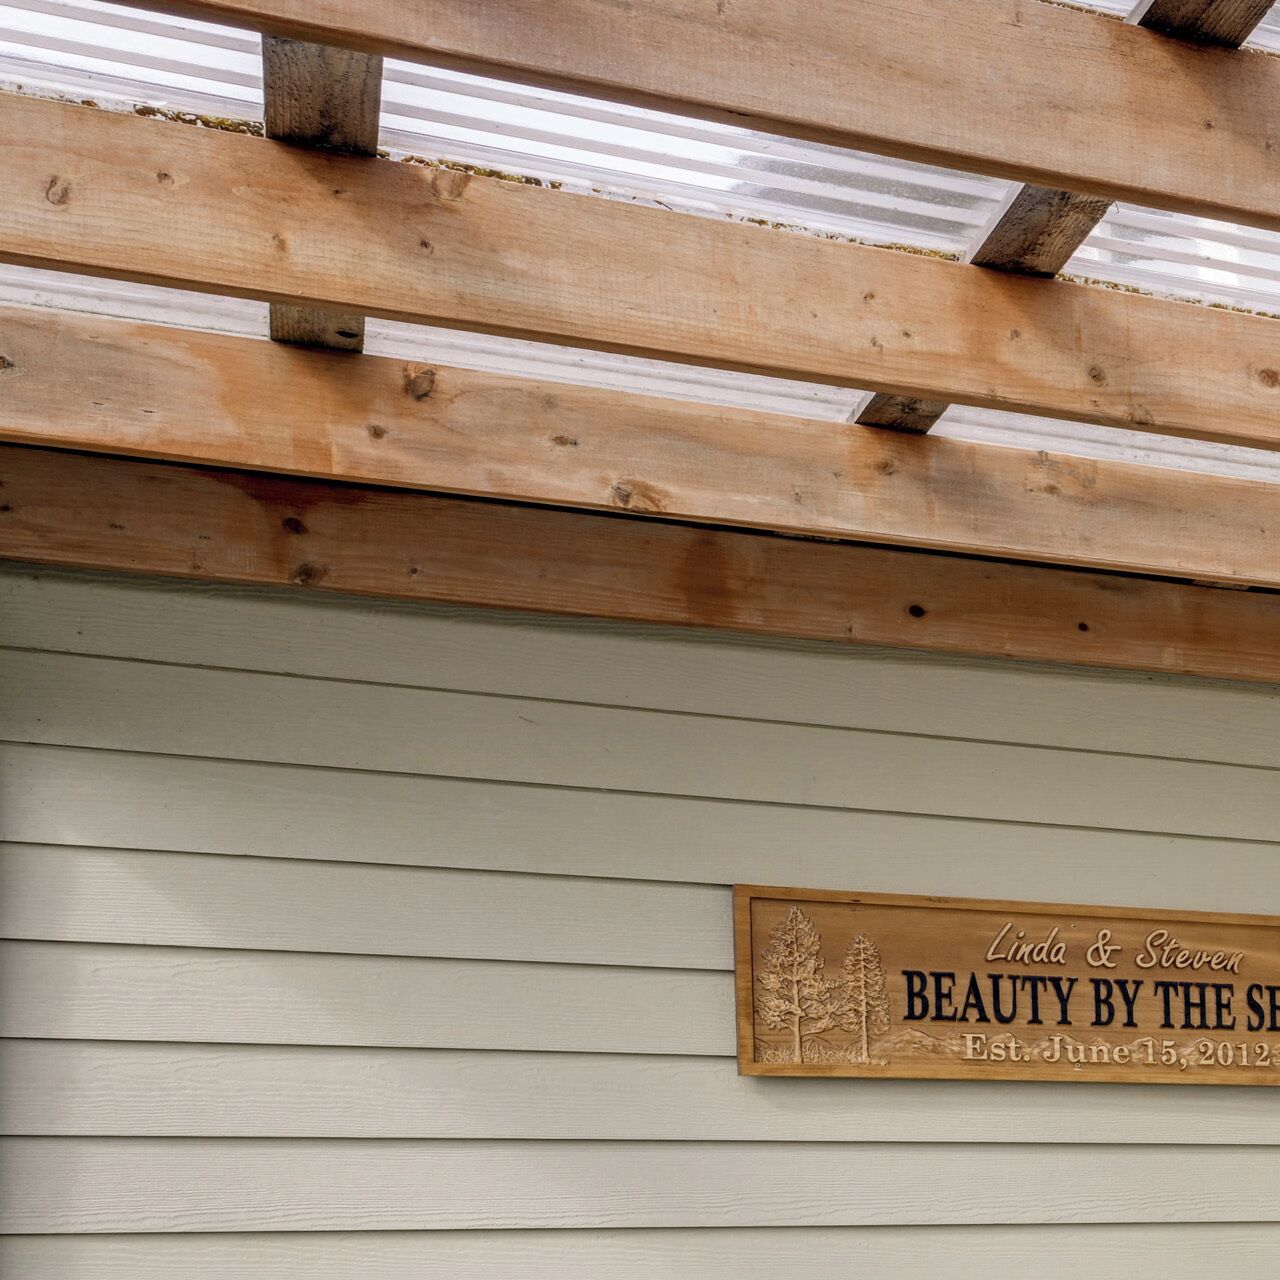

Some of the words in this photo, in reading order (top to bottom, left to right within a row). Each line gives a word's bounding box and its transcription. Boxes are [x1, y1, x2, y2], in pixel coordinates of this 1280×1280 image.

[985, 921, 1067, 965] Linda
[1086, 928, 1122, 968] &
[1136, 929, 1245, 976] Steven
[902, 969, 1078, 1026] BEAUTY
[1089, 977, 1144, 1028] BY
[1154, 980, 1236, 1031] THE
[961, 1032, 1030, 1063] Est.
[1043, 1035, 1131, 1064] June
[1143, 1038, 1188, 1070] 15,
[1199, 1040, 1272, 1069] 2012
